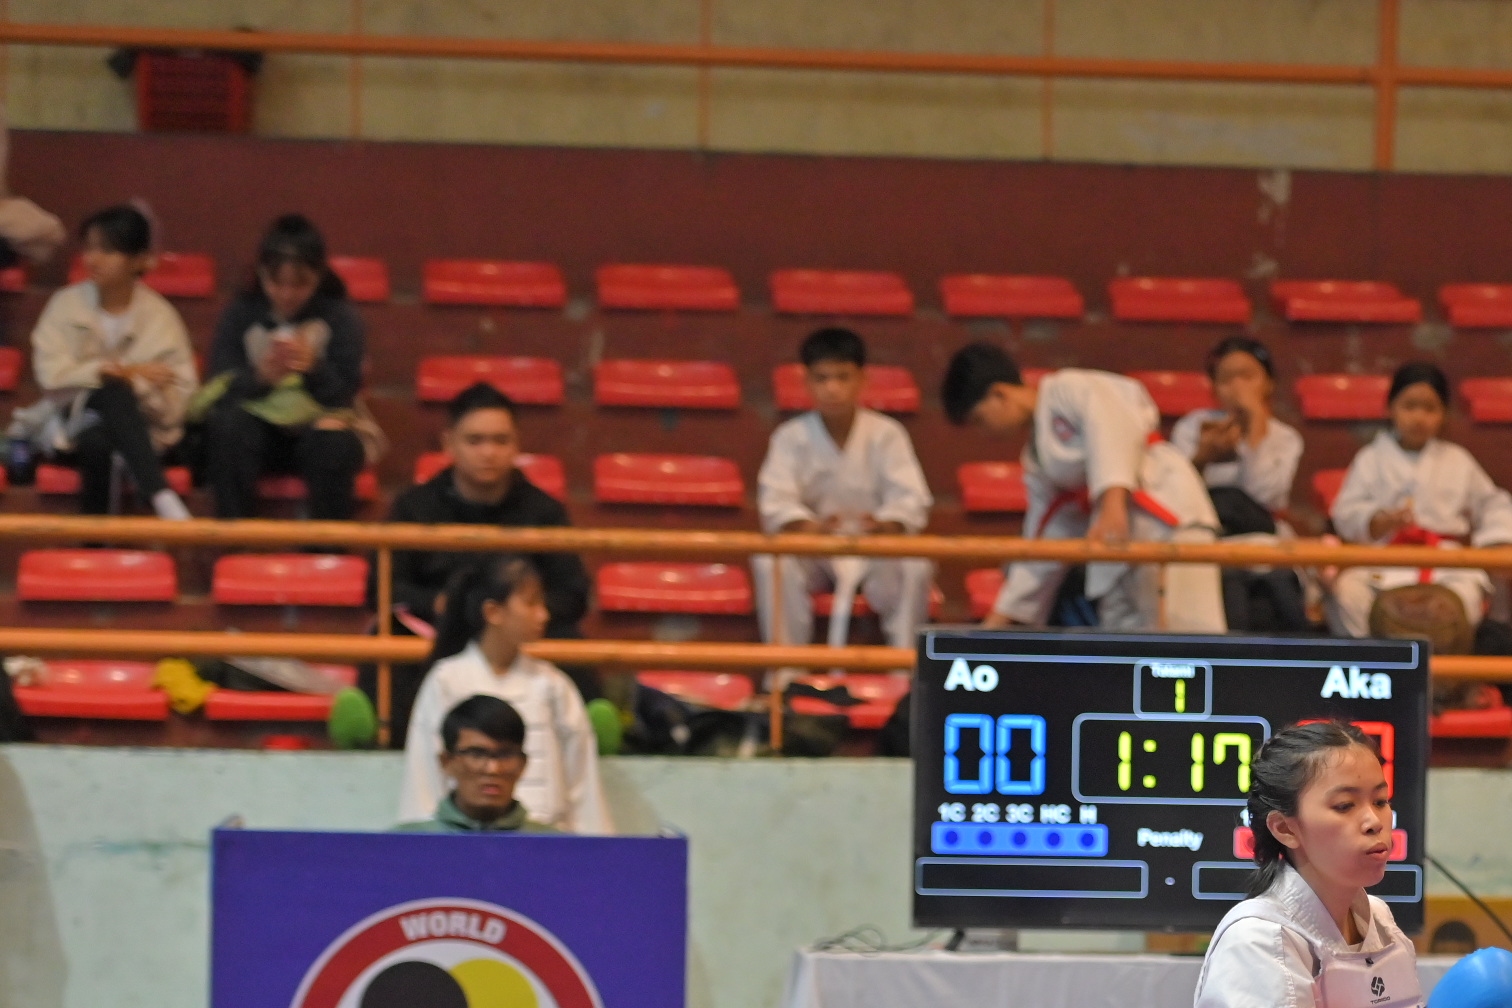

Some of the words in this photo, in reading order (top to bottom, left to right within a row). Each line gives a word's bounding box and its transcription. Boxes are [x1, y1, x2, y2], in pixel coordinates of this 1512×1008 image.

[944, 658, 999, 692] Ao
[1321, 665, 1392, 699] Aka
[1174, 678, 1186, 713] 1
[944, 713, 1046, 795] 00
[1117, 731, 1252, 793] 1:17
[938, 802, 966, 822] 1C
[971, 803, 1000, 823] 2C
[1005, 803, 1034, 823] 3C
[1040, 804, 1072, 824] HC
[1079, 804, 1097, 824] H
[1137, 828, 1203, 851] Penalty
[400, 911, 507, 943] WORLD
